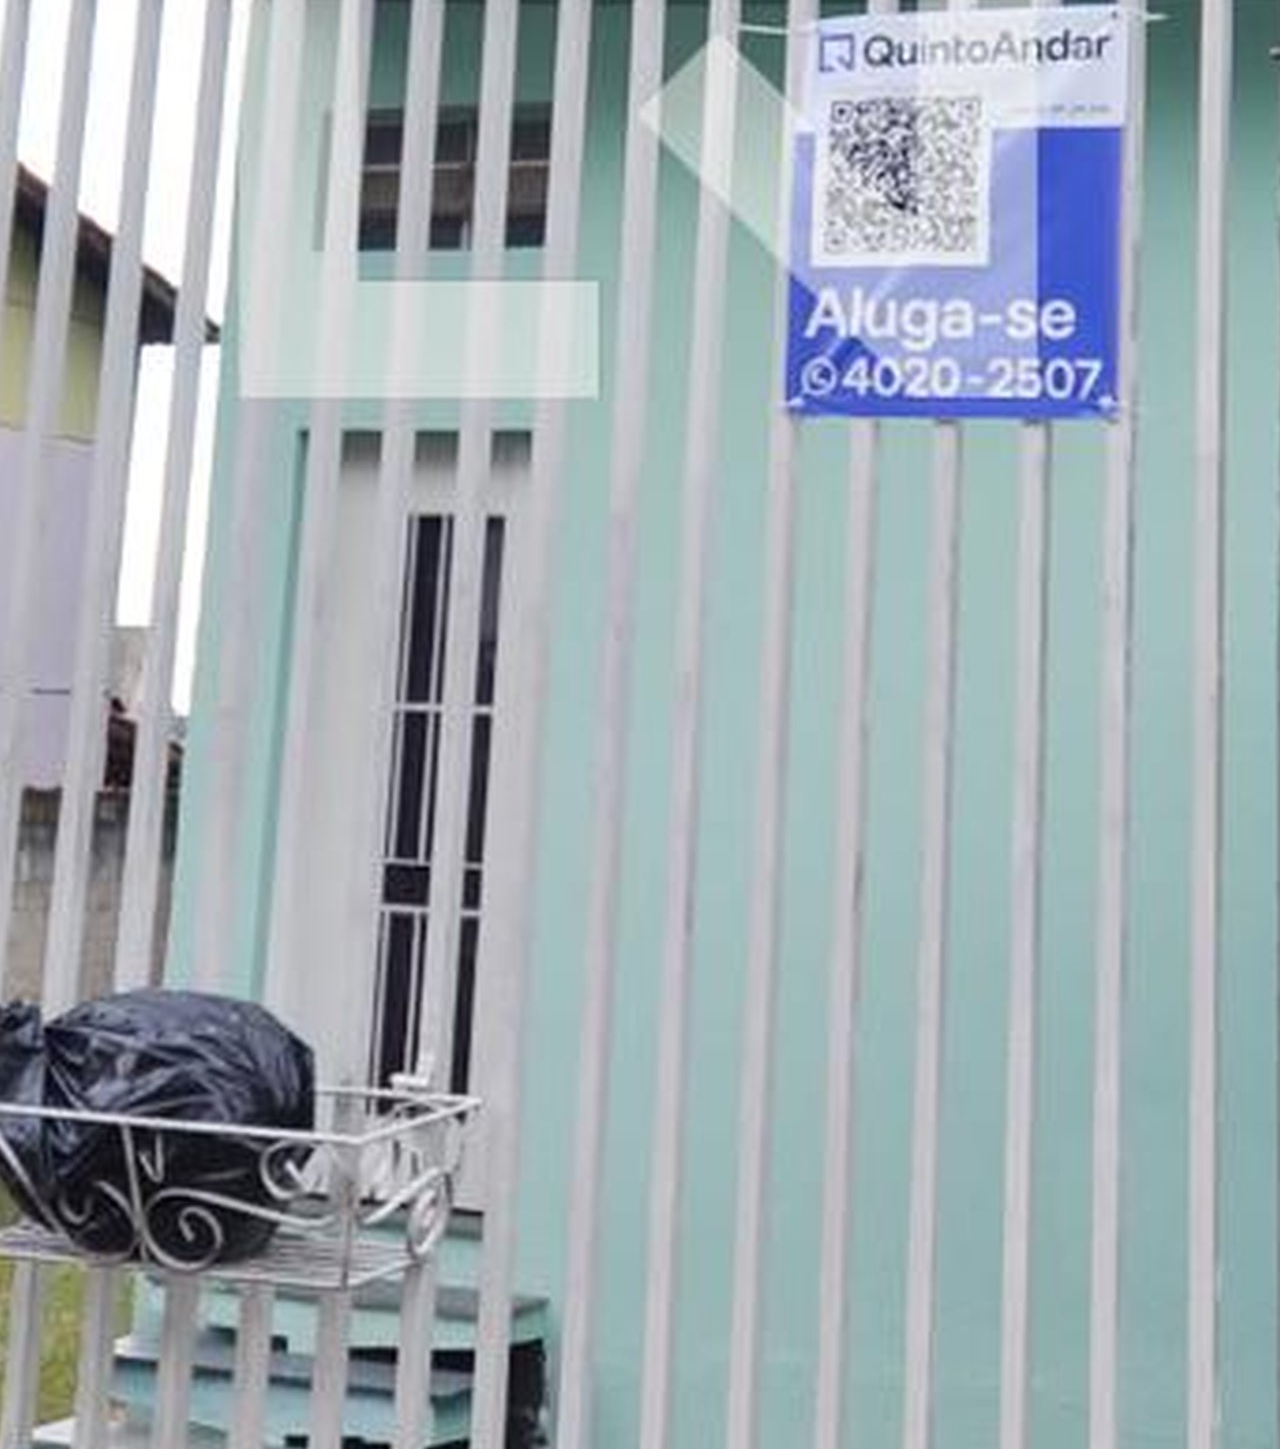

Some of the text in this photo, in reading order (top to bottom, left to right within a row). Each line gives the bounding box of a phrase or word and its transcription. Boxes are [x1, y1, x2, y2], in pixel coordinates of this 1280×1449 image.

[863, 29, 1111, 67] QuintoAndar
[804, 288, 1077, 350] Aluga-se
[842, 357, 1103, 400] 4020-2507
